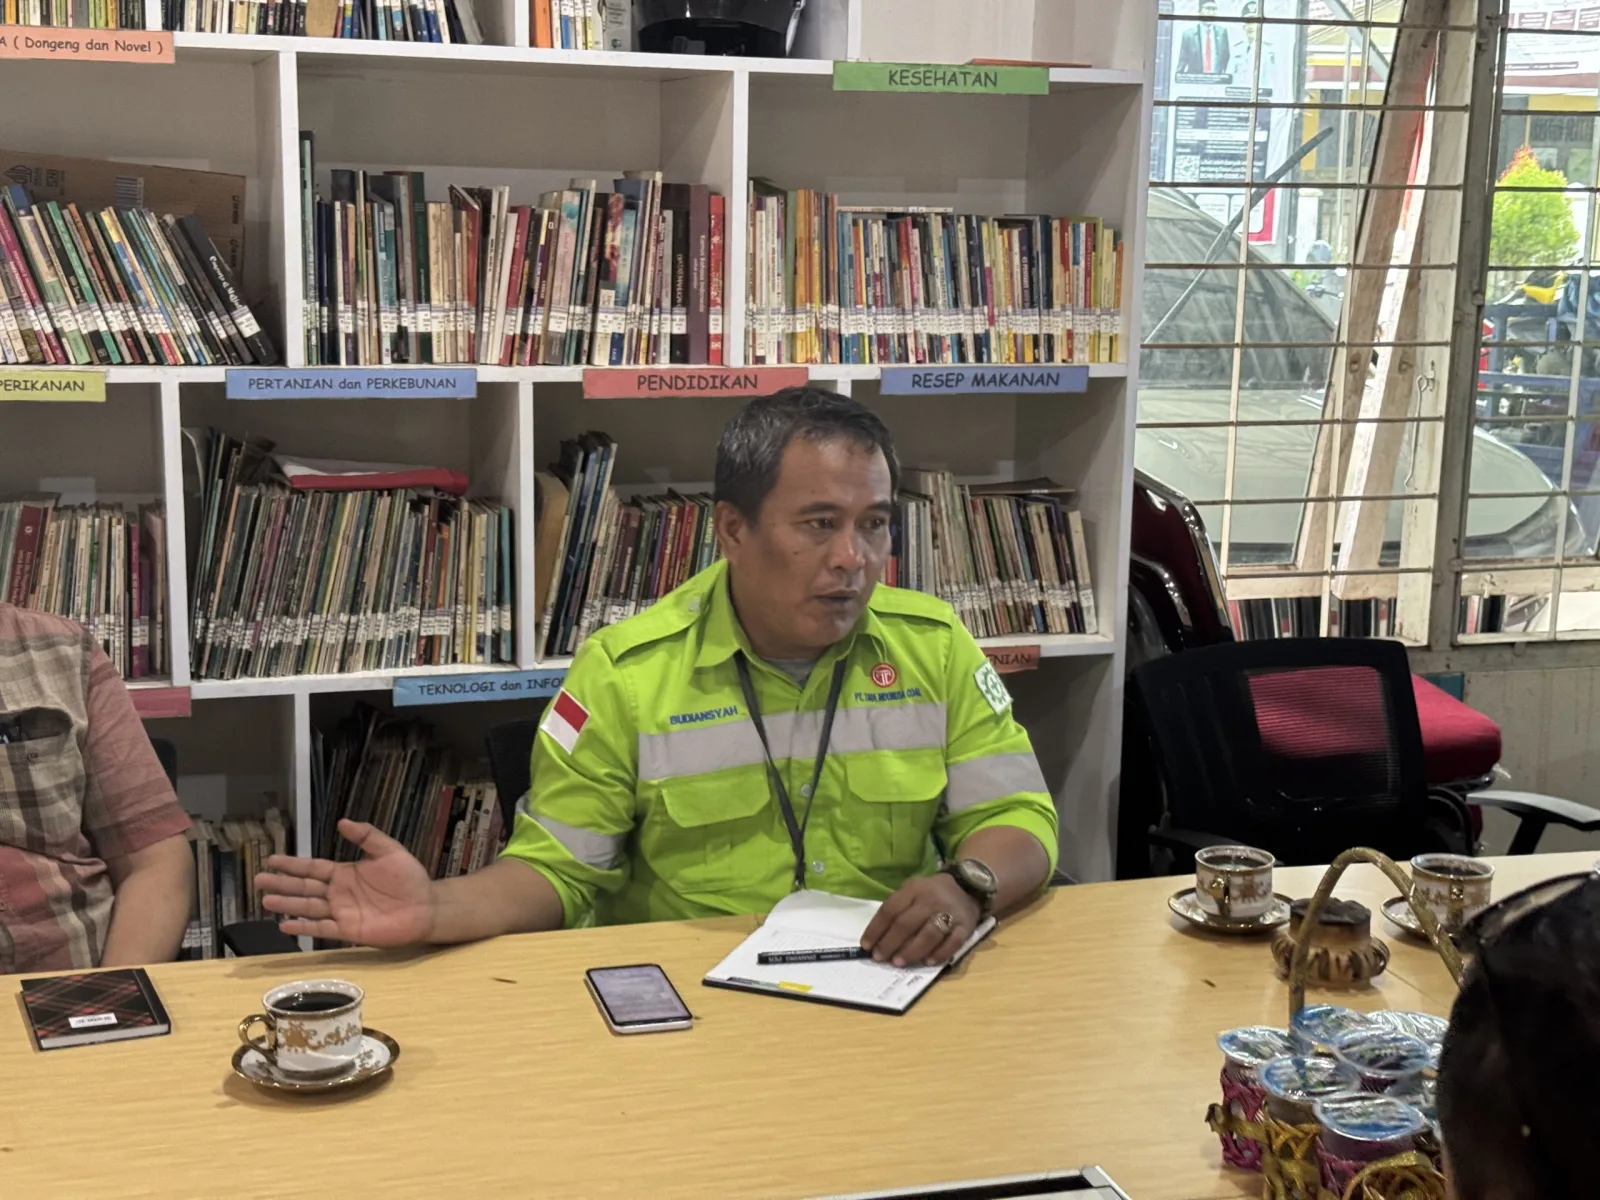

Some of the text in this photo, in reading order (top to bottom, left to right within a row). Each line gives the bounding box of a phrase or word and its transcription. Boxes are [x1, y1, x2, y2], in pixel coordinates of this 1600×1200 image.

[25, 36, 80, 53] Dongeng
[86, 38, 109, 51] dan
[115, 40, 151, 53] Novel
[888, 69, 998, 87] KESEHATAN
[248, 377, 456, 390] PERTANIAN dan PERKEBUNAN
[637, 374, 758, 391] PENDIDIKAN
[911, 372, 1060, 389] RESEP MAKANAN
[418, 677, 564, 696] TEKNOLOGI dan INFO
[669, 705, 738, 725] BUDIANSYAH
